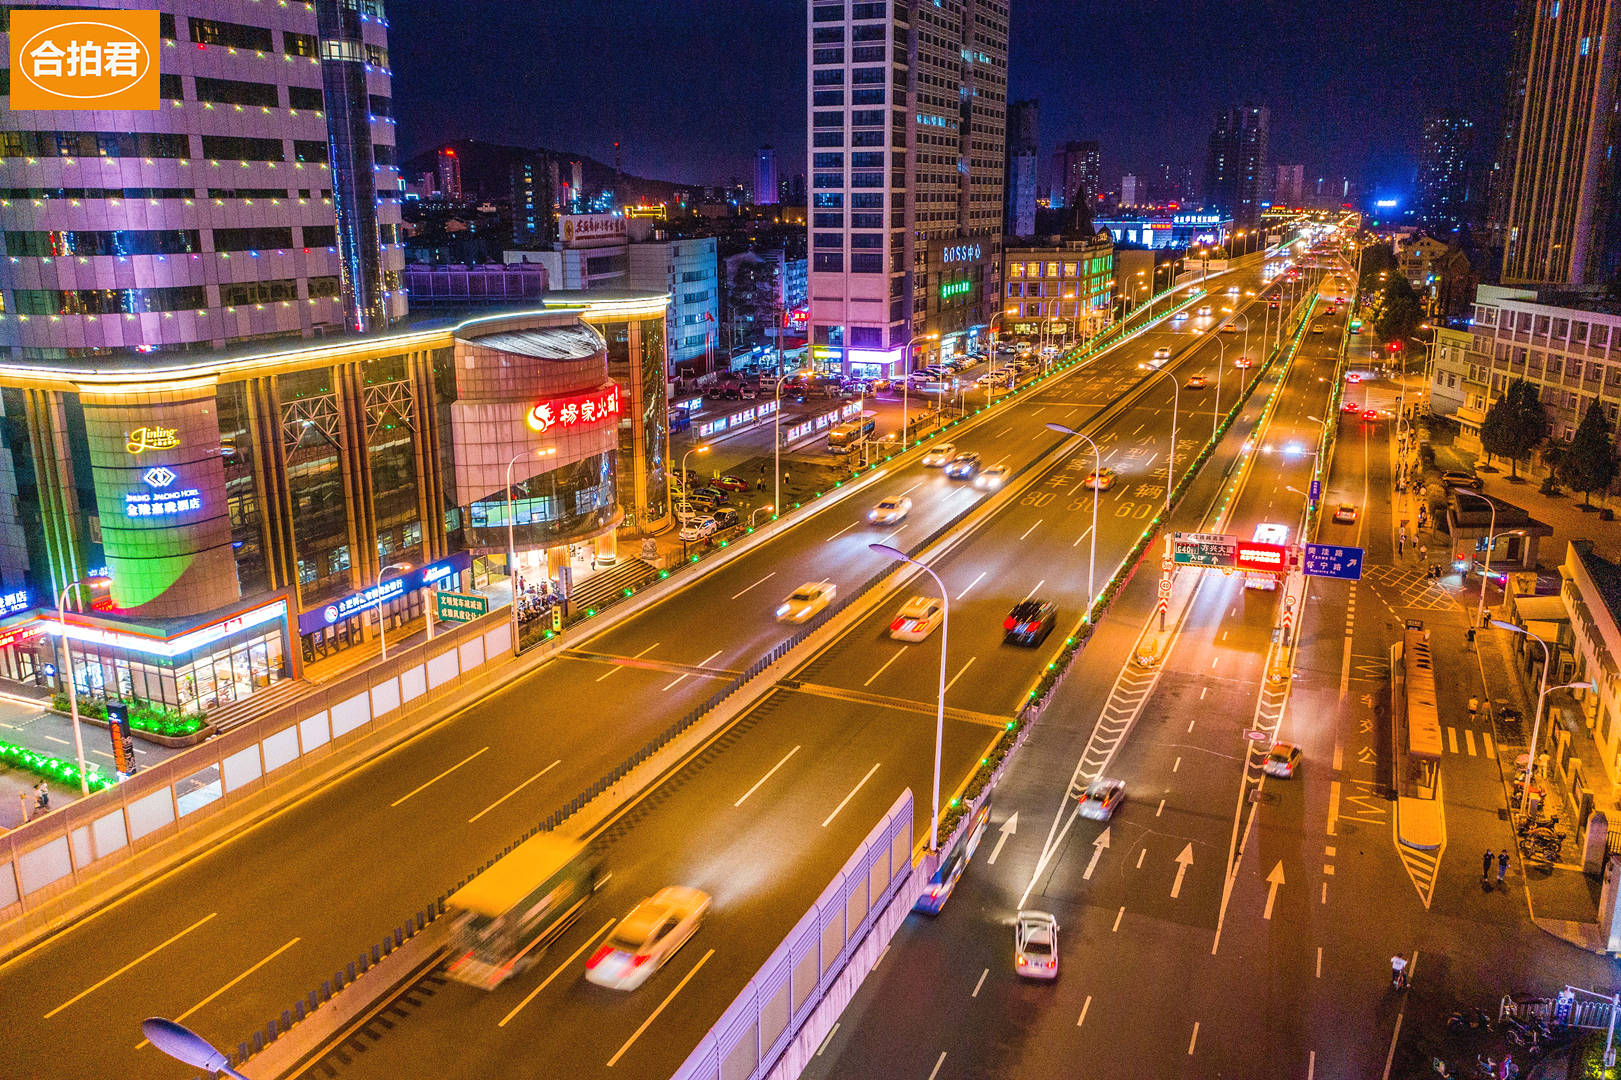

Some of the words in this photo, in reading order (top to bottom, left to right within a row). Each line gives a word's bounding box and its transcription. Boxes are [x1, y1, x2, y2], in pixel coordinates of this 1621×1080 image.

[1020, 491, 1057, 507] 80
[1114, 503, 1152, 519] 60
[1201, 544, 1233, 553] 方兴大道
[339, 578, 403, 613] 合肥科农村商业银行
